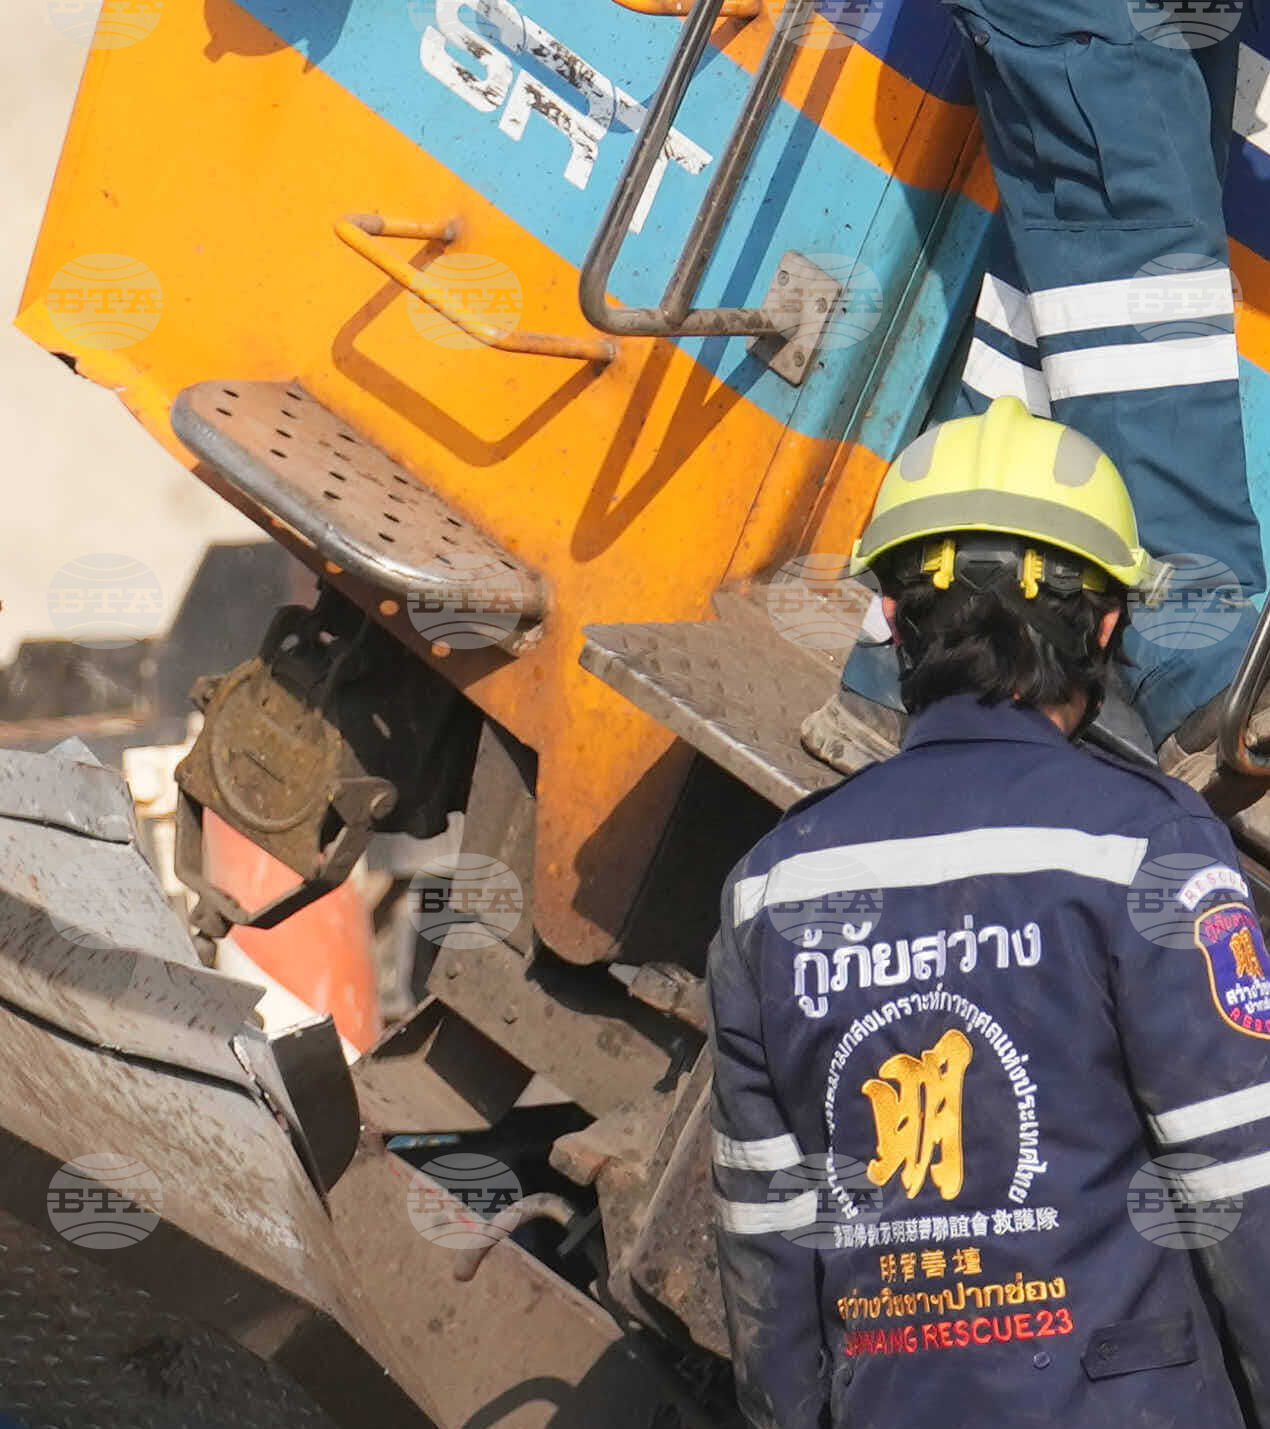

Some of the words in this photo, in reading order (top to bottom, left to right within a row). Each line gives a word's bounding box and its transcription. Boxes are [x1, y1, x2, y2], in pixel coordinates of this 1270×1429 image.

[793, 915, 1043, 1018] กู้ภัยสว่าง
